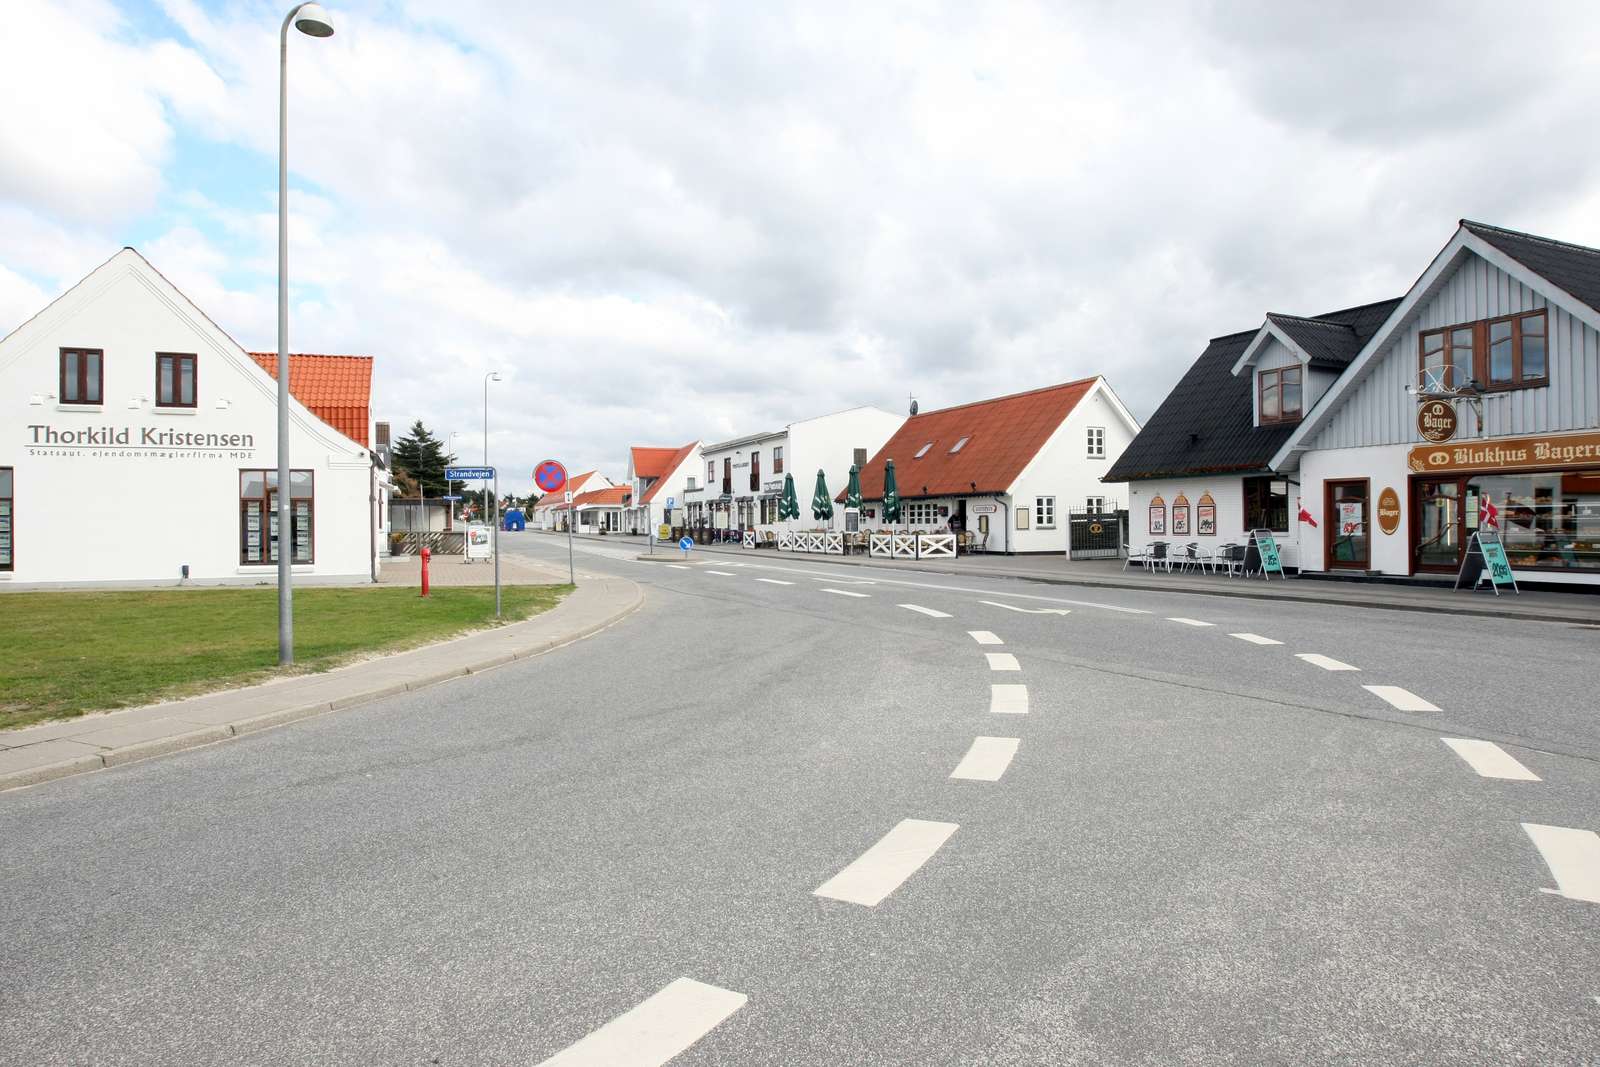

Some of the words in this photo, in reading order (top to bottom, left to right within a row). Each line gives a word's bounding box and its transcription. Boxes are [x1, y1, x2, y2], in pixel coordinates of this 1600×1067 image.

[1424, 412, 1453, 431] Bager
[27, 424, 129, 445] Thorkild
[141, 427, 254, 447] Kristensen
[30, 449, 86, 457] Statsaut.
[1453, 446, 1528, 465] Blokhus
[449, 471, 490, 480] Strandvejen
